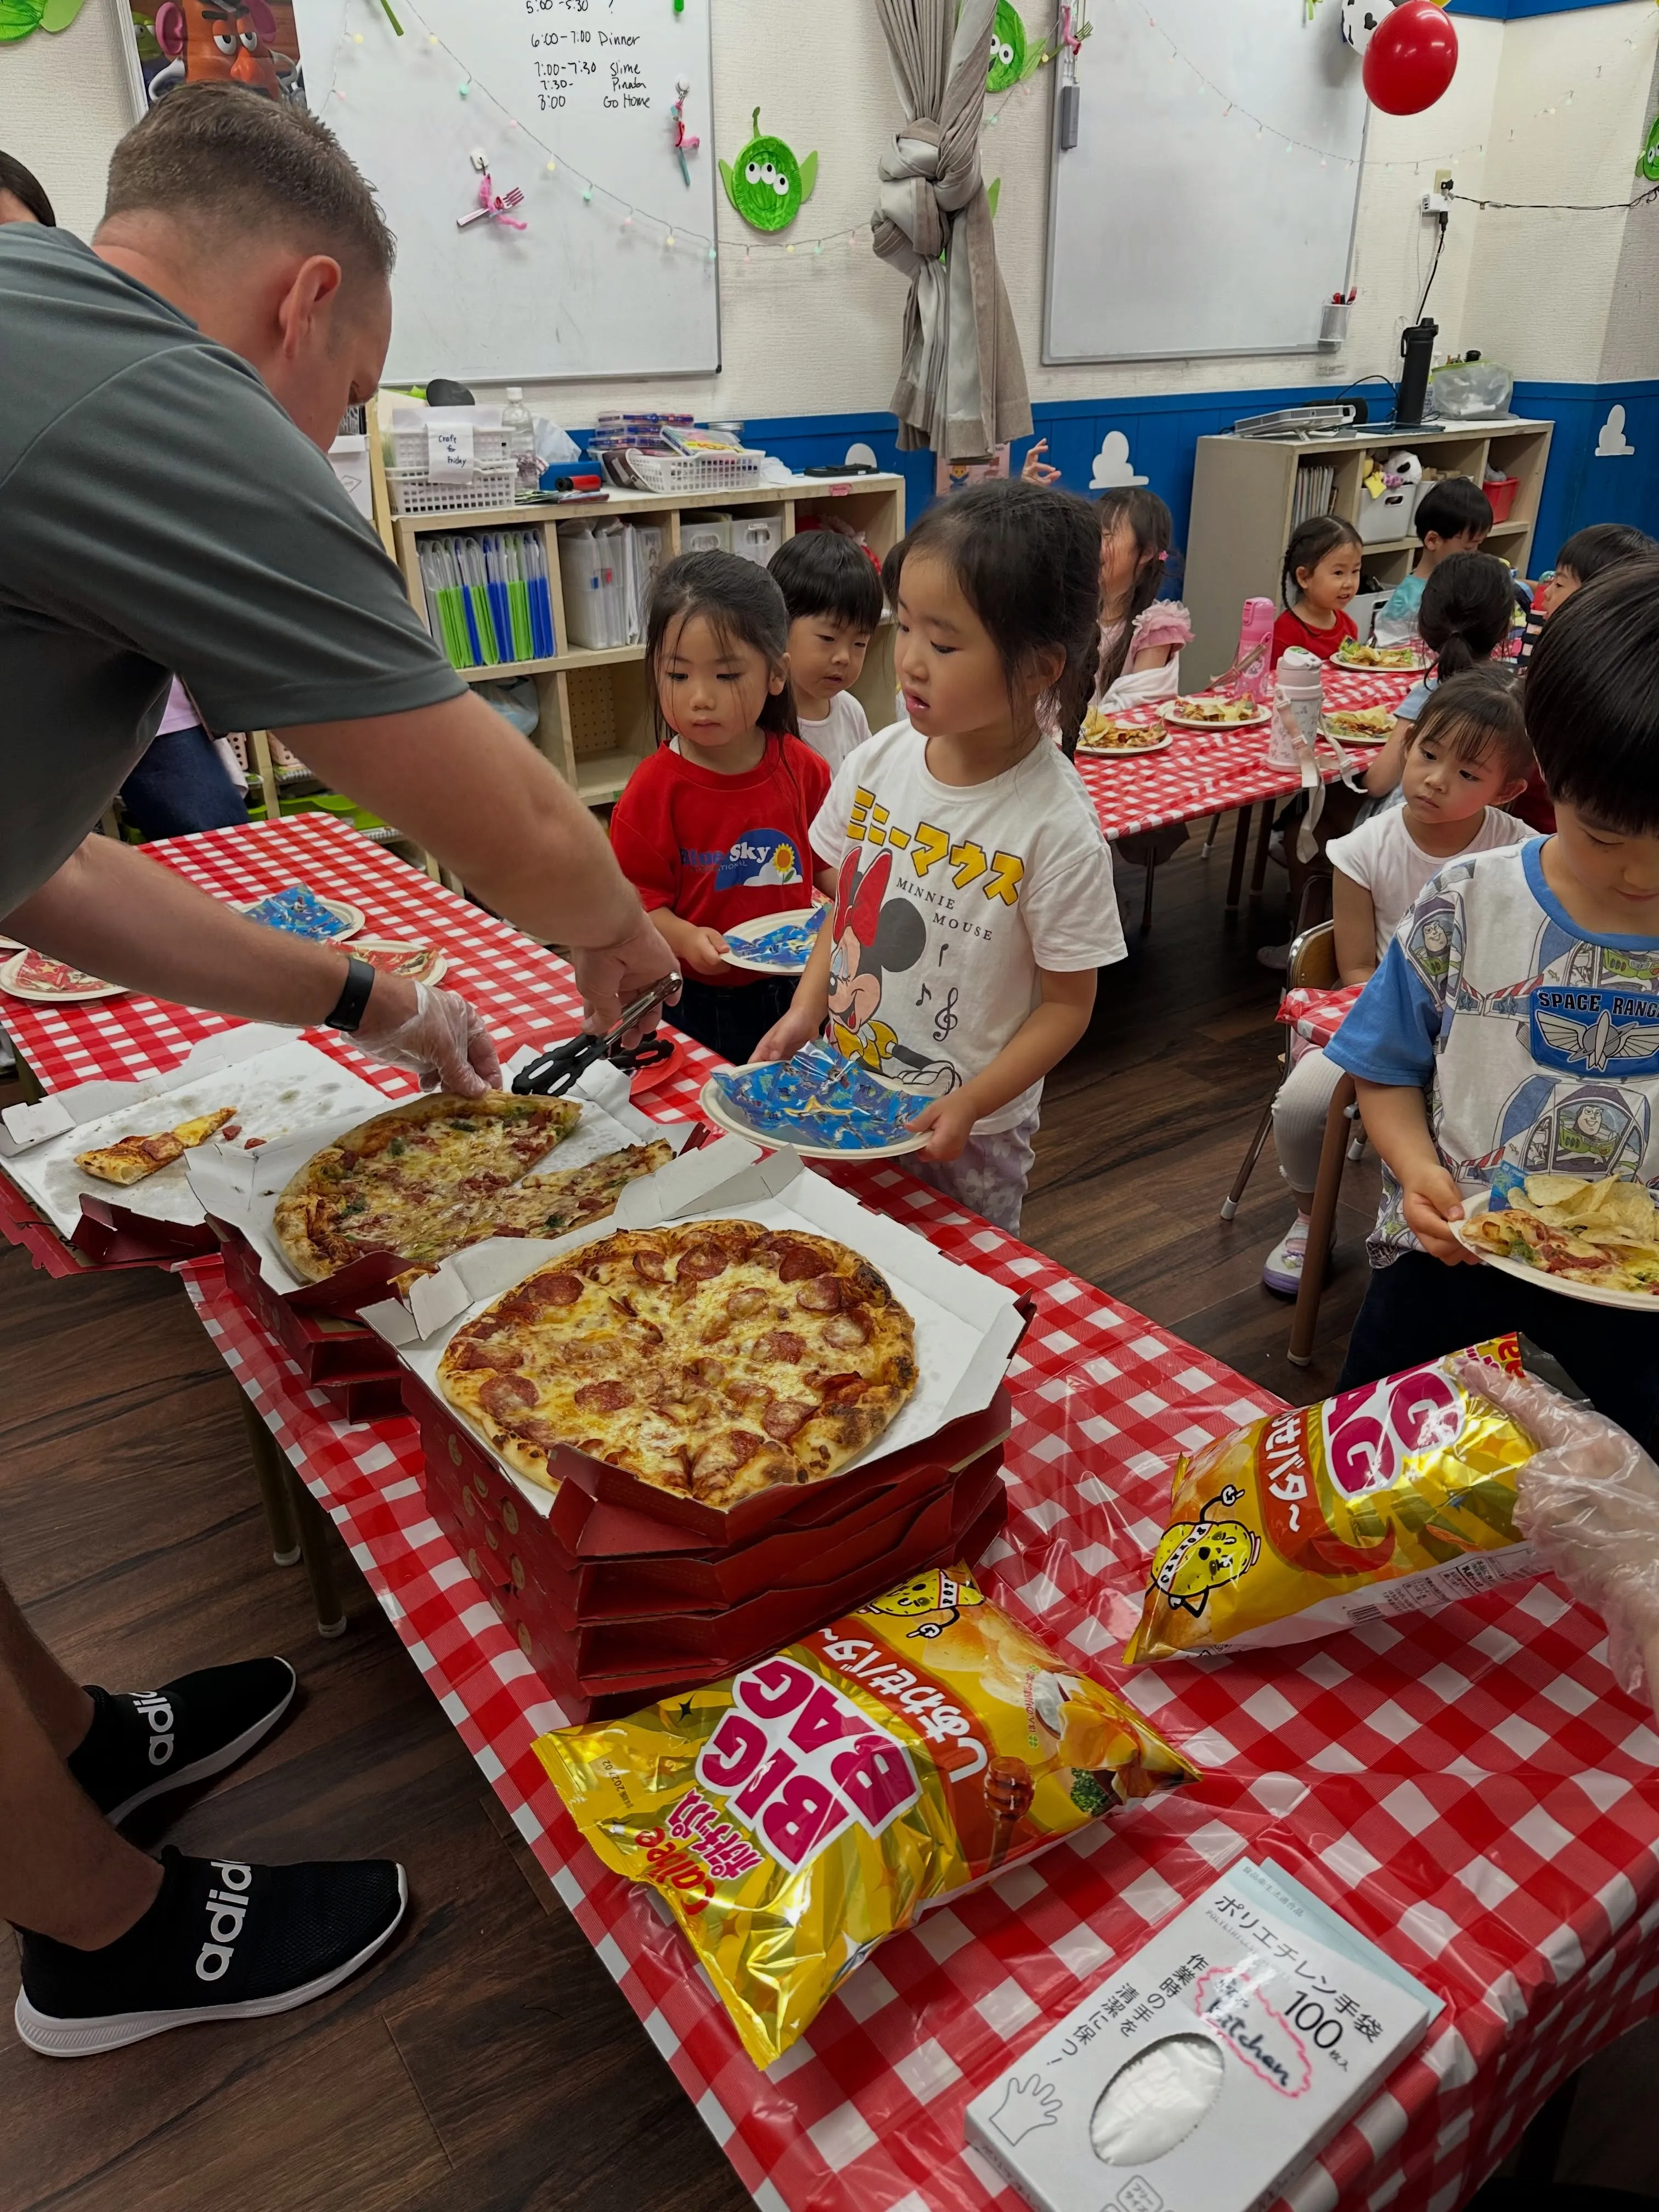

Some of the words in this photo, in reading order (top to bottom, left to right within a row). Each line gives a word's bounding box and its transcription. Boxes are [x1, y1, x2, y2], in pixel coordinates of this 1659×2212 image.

[598, 31, 640, 46] Dinner
[538, 94, 566, 110] 8:00
[603, 96, 618, 108] Go
[624, 93, 650, 108] Home
[448, 455, 466, 468] Friday
[680, 848, 725, 867] Blue
[730, 842, 770, 864] Sky
[847, 786, 1024, 906] ミニーマウス
[896, 878, 955, 910] MINNIE
[933, 913, 992, 941] MOUSE
[1538, 992, 1602, 1012] SPACE
[1160, 1526, 1206, 1583] POTATO
[740, 1660, 916, 1827] BAG
[702, 1715, 849, 1865] BIG
[635, 1826, 715, 1915] Calbee
[195, 1859, 252, 1981] adid
[1120, 1954, 1209, 2038] 作業時の手を
[1215, 1895, 1384, 2044] ポリエチレン手袋
